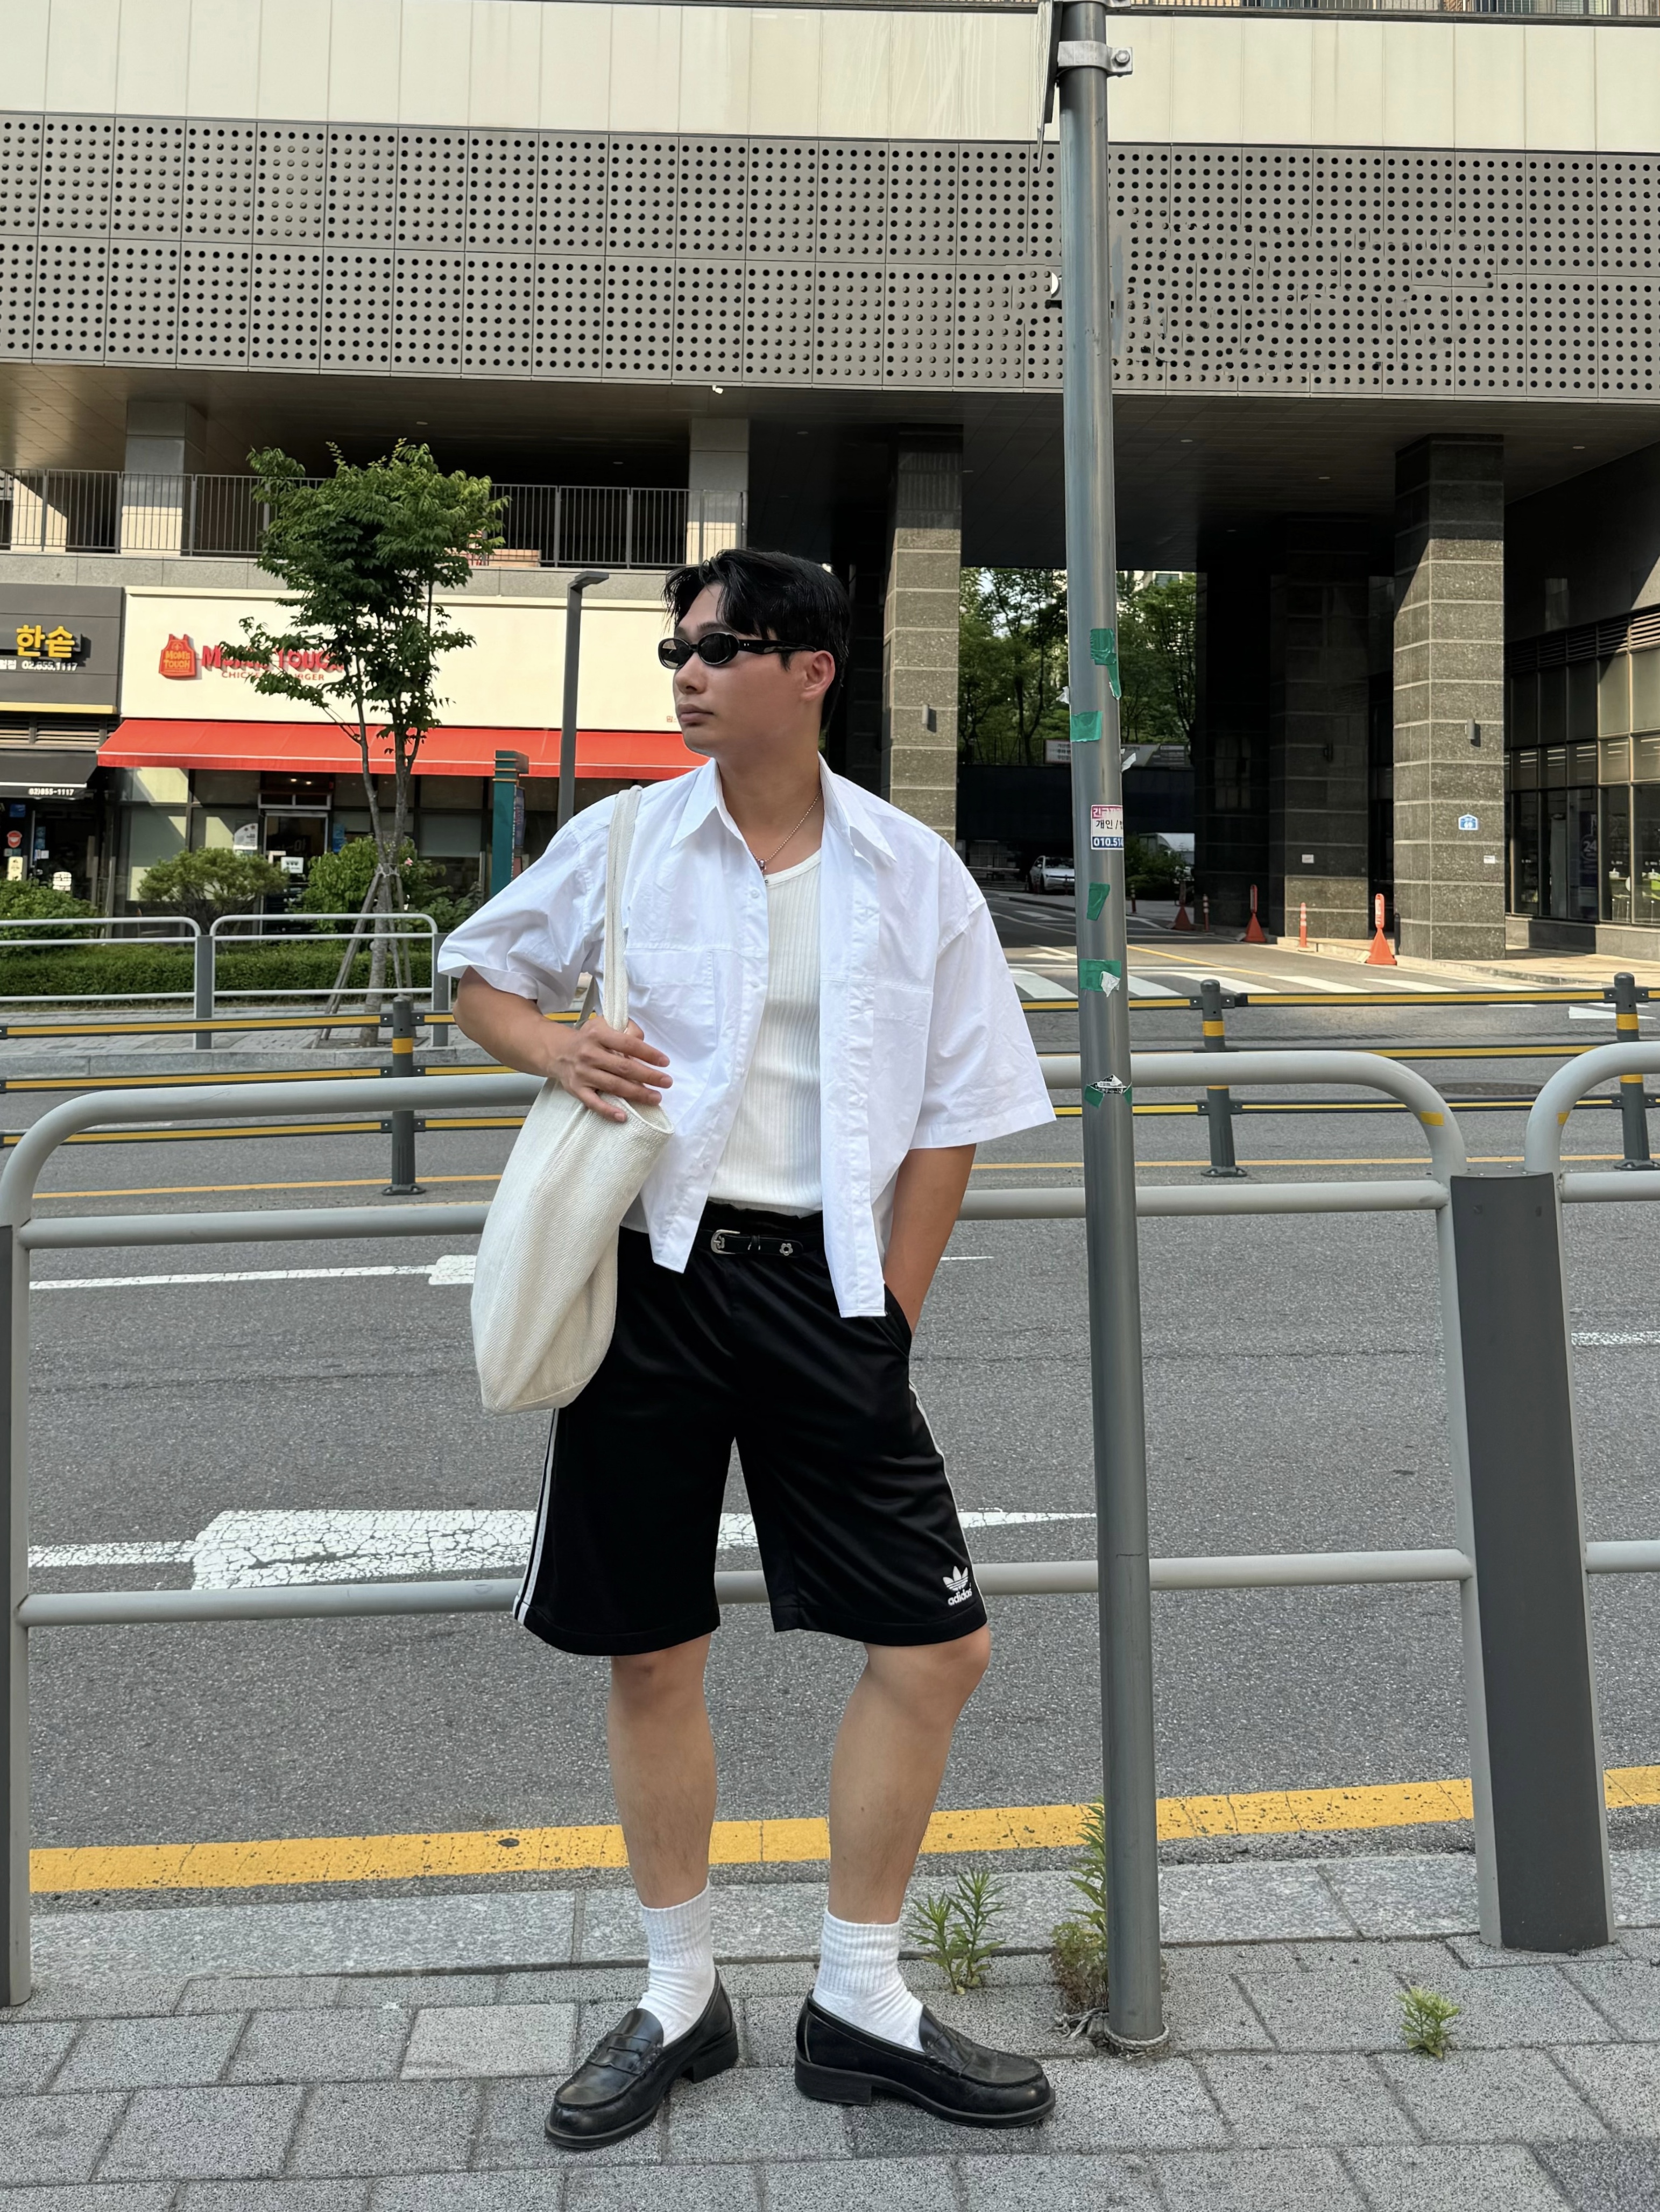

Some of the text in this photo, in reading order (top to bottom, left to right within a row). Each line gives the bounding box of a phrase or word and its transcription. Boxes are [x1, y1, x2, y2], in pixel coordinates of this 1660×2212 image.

[16, 624, 75, 658] 한솥
[163, 659, 190, 669] TOUCH
[948, 1588, 972, 1606] adidas
